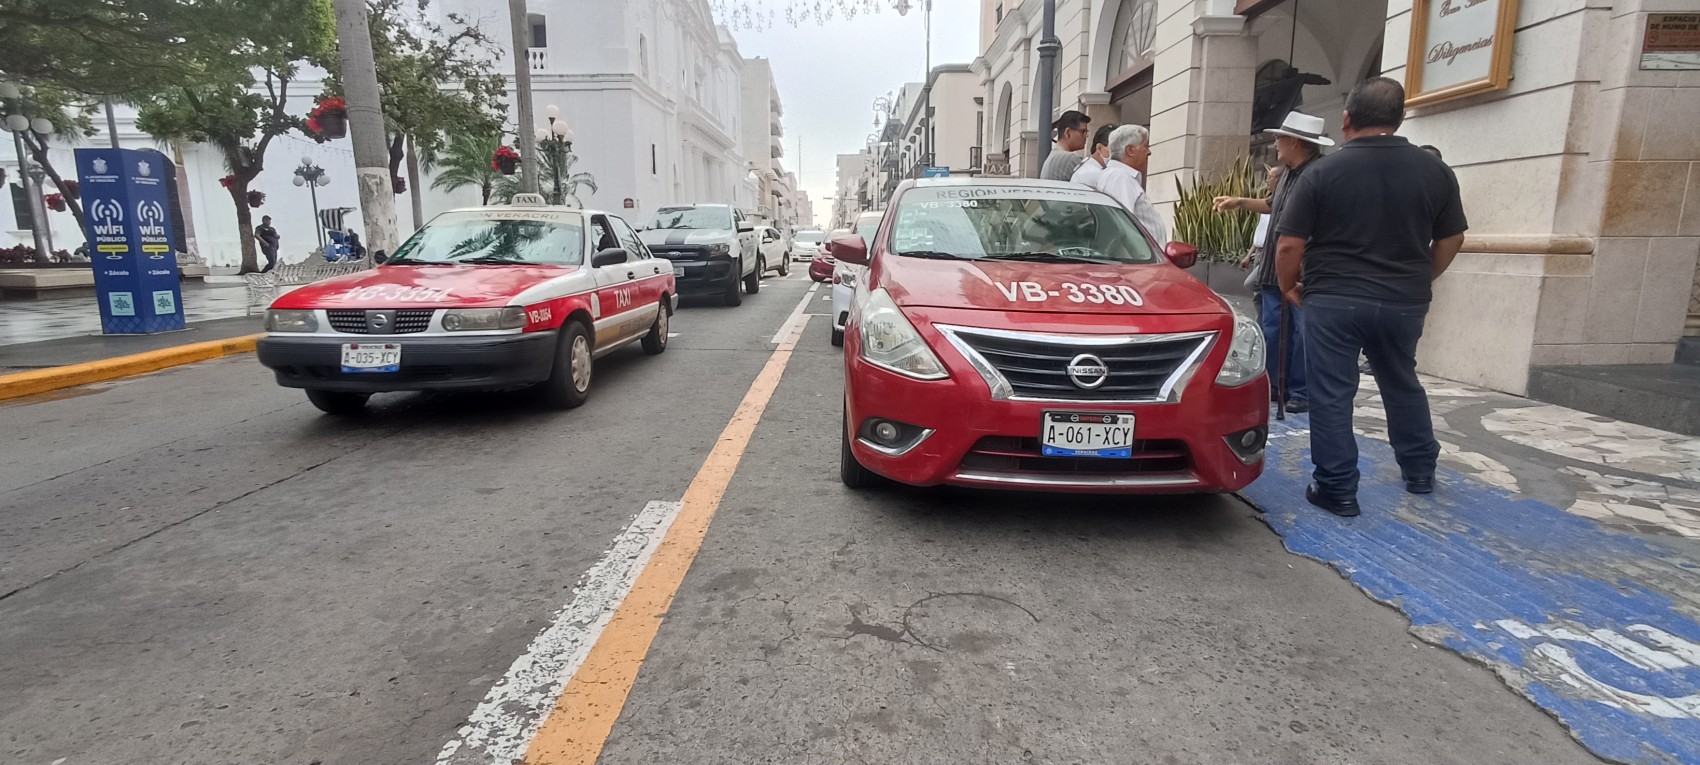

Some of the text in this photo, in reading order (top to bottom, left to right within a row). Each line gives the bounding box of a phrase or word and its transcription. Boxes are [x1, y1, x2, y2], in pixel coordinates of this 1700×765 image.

[1426, 34, 1494, 66] Diligencias
[984, 164, 1010, 175] TAXI
[936, 187, 997, 200] REGIÓN
[497, 212, 560, 220] VERACRU
[94, 222, 124, 235] WIFI
[139, 222, 165, 235] WIFI
[342, 286, 454, 302] VB-3354
[614, 288, 631, 309] TAXI
[994, 282, 1143, 306] VB-3380
[528, 308, 552, 324] VB-3354
[344, 352, 398, 364] A-035-XCY
[1048, 425, 1130, 446] A-061-XCY
